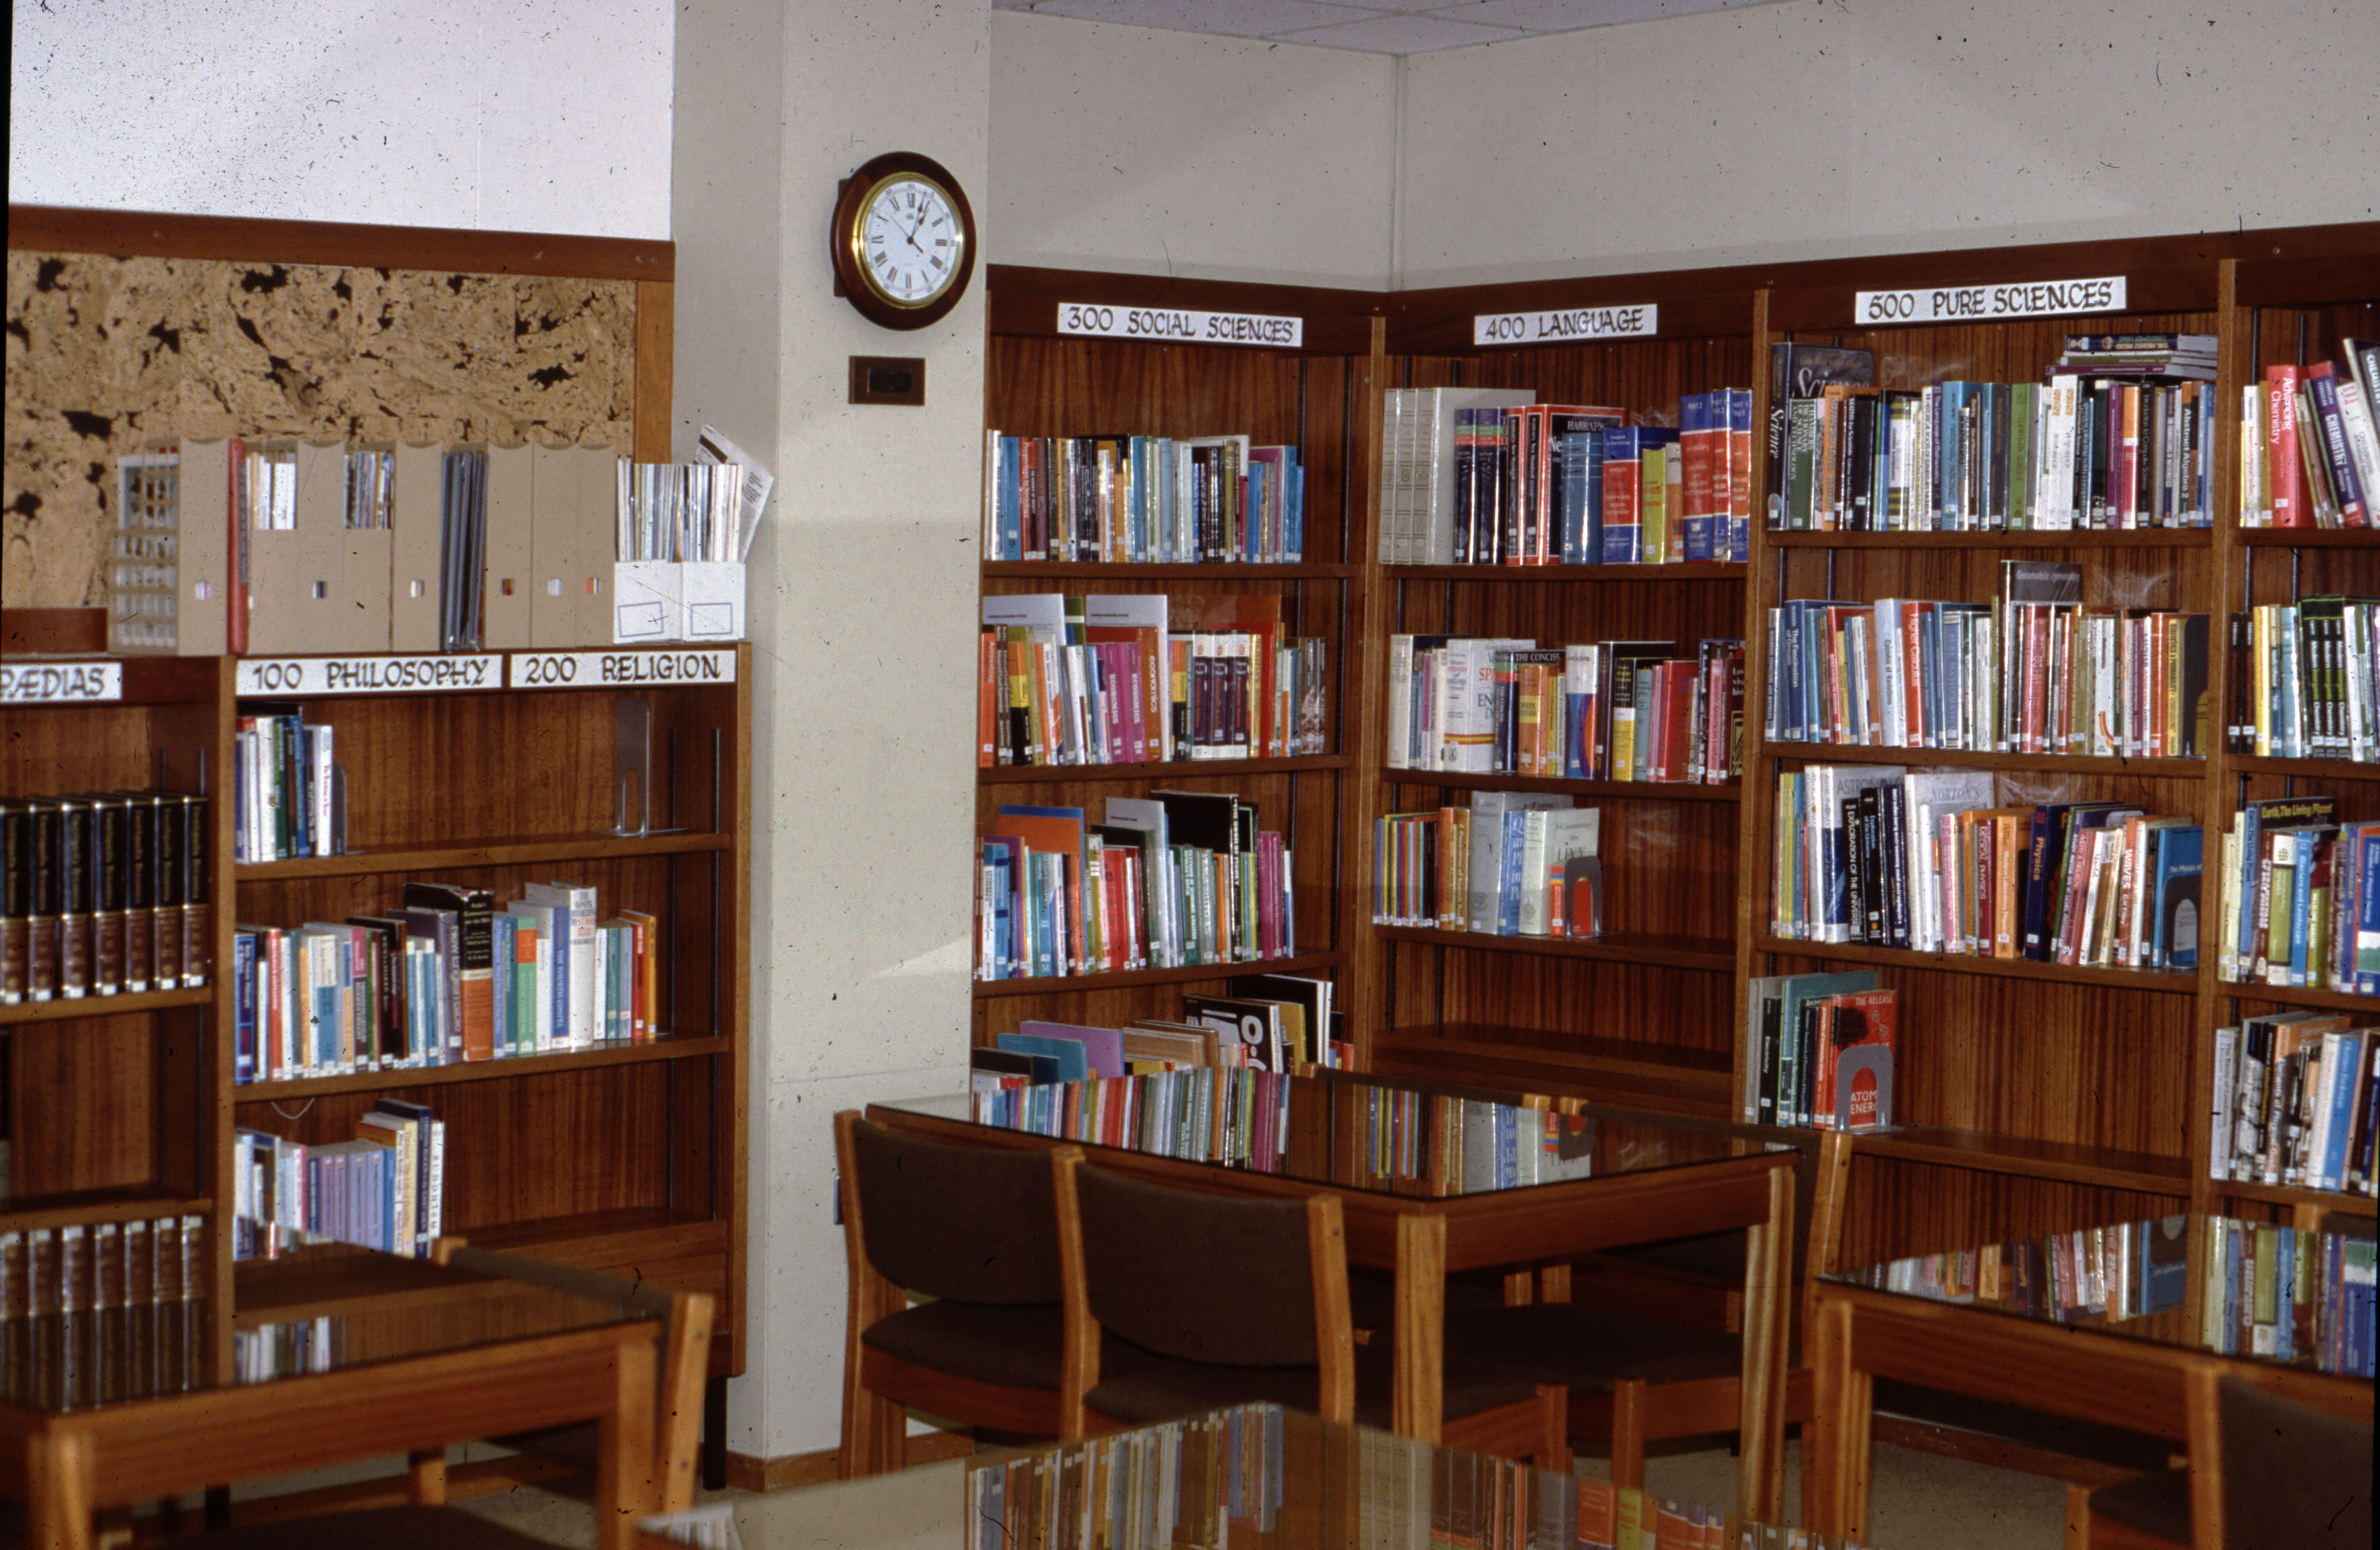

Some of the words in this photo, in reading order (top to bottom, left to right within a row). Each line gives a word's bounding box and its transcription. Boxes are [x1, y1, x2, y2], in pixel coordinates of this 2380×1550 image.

[1868, 292, 1914, 319] 500
[1932, 289, 1986, 317] PURE
[1992, 281, 2113, 314] SCIENCES
[1067, 306, 1113, 331] 300
[1127, 310, 1196, 338] SOCIAL
[1207, 316, 1294, 343] SCIENCES
[1485, 316, 1526, 340] 400
[1538, 308, 1644, 338] LANGUAGE
[1829, 397, 1838, 445] ADVANCED
[2270, 391, 2281, 444] Chemistry
[2282, 378, 2293, 430] Advancing
[1770, 406, 1785, 459] Science
[2183, 408, 2192, 451] Abstract
[2325, 413, 2347, 466] CHEMISTRY
[1828, 447, 1836, 471] LEVEL
[2182, 453, 2190, 490] Algebra
[1909, 613, 1919, 644] Higher
[253, 662, 303, 691] 100
[327, 657, 490, 690] PHILOSOPHY
[525, 656, 577, 683] 200
[602, 655, 722, 682] RELIGION
[1150, 655, 1158, 713] economics
[1911, 647, 1920, 687] Calculus
[1109, 673, 1118, 724] ECONOMICS
[2313, 701, 2321, 736] Chemistry
[2337, 701, 2346, 736] Chemistry
[1847, 811, 1857, 862] EXPLORATION
[1979, 826, 1987, 862] MEDICAL
[1850, 863, 1857, 875] OF
[2032, 837, 2045, 881] Physics
[2122, 849, 2133, 889] WAVES
[2001, 877, 2009, 910] Laboratory
[2295, 904, 2303, 944] Landscape
[1856, 997, 1866, 1006] THE
[1868, 995, 1893, 1005] RELEASE
[2275, 1058, 2285, 1097] Elements
[2273, 1099, 2281, 1108] of
[430, 1155, 440, 1230] BUDDHISM
